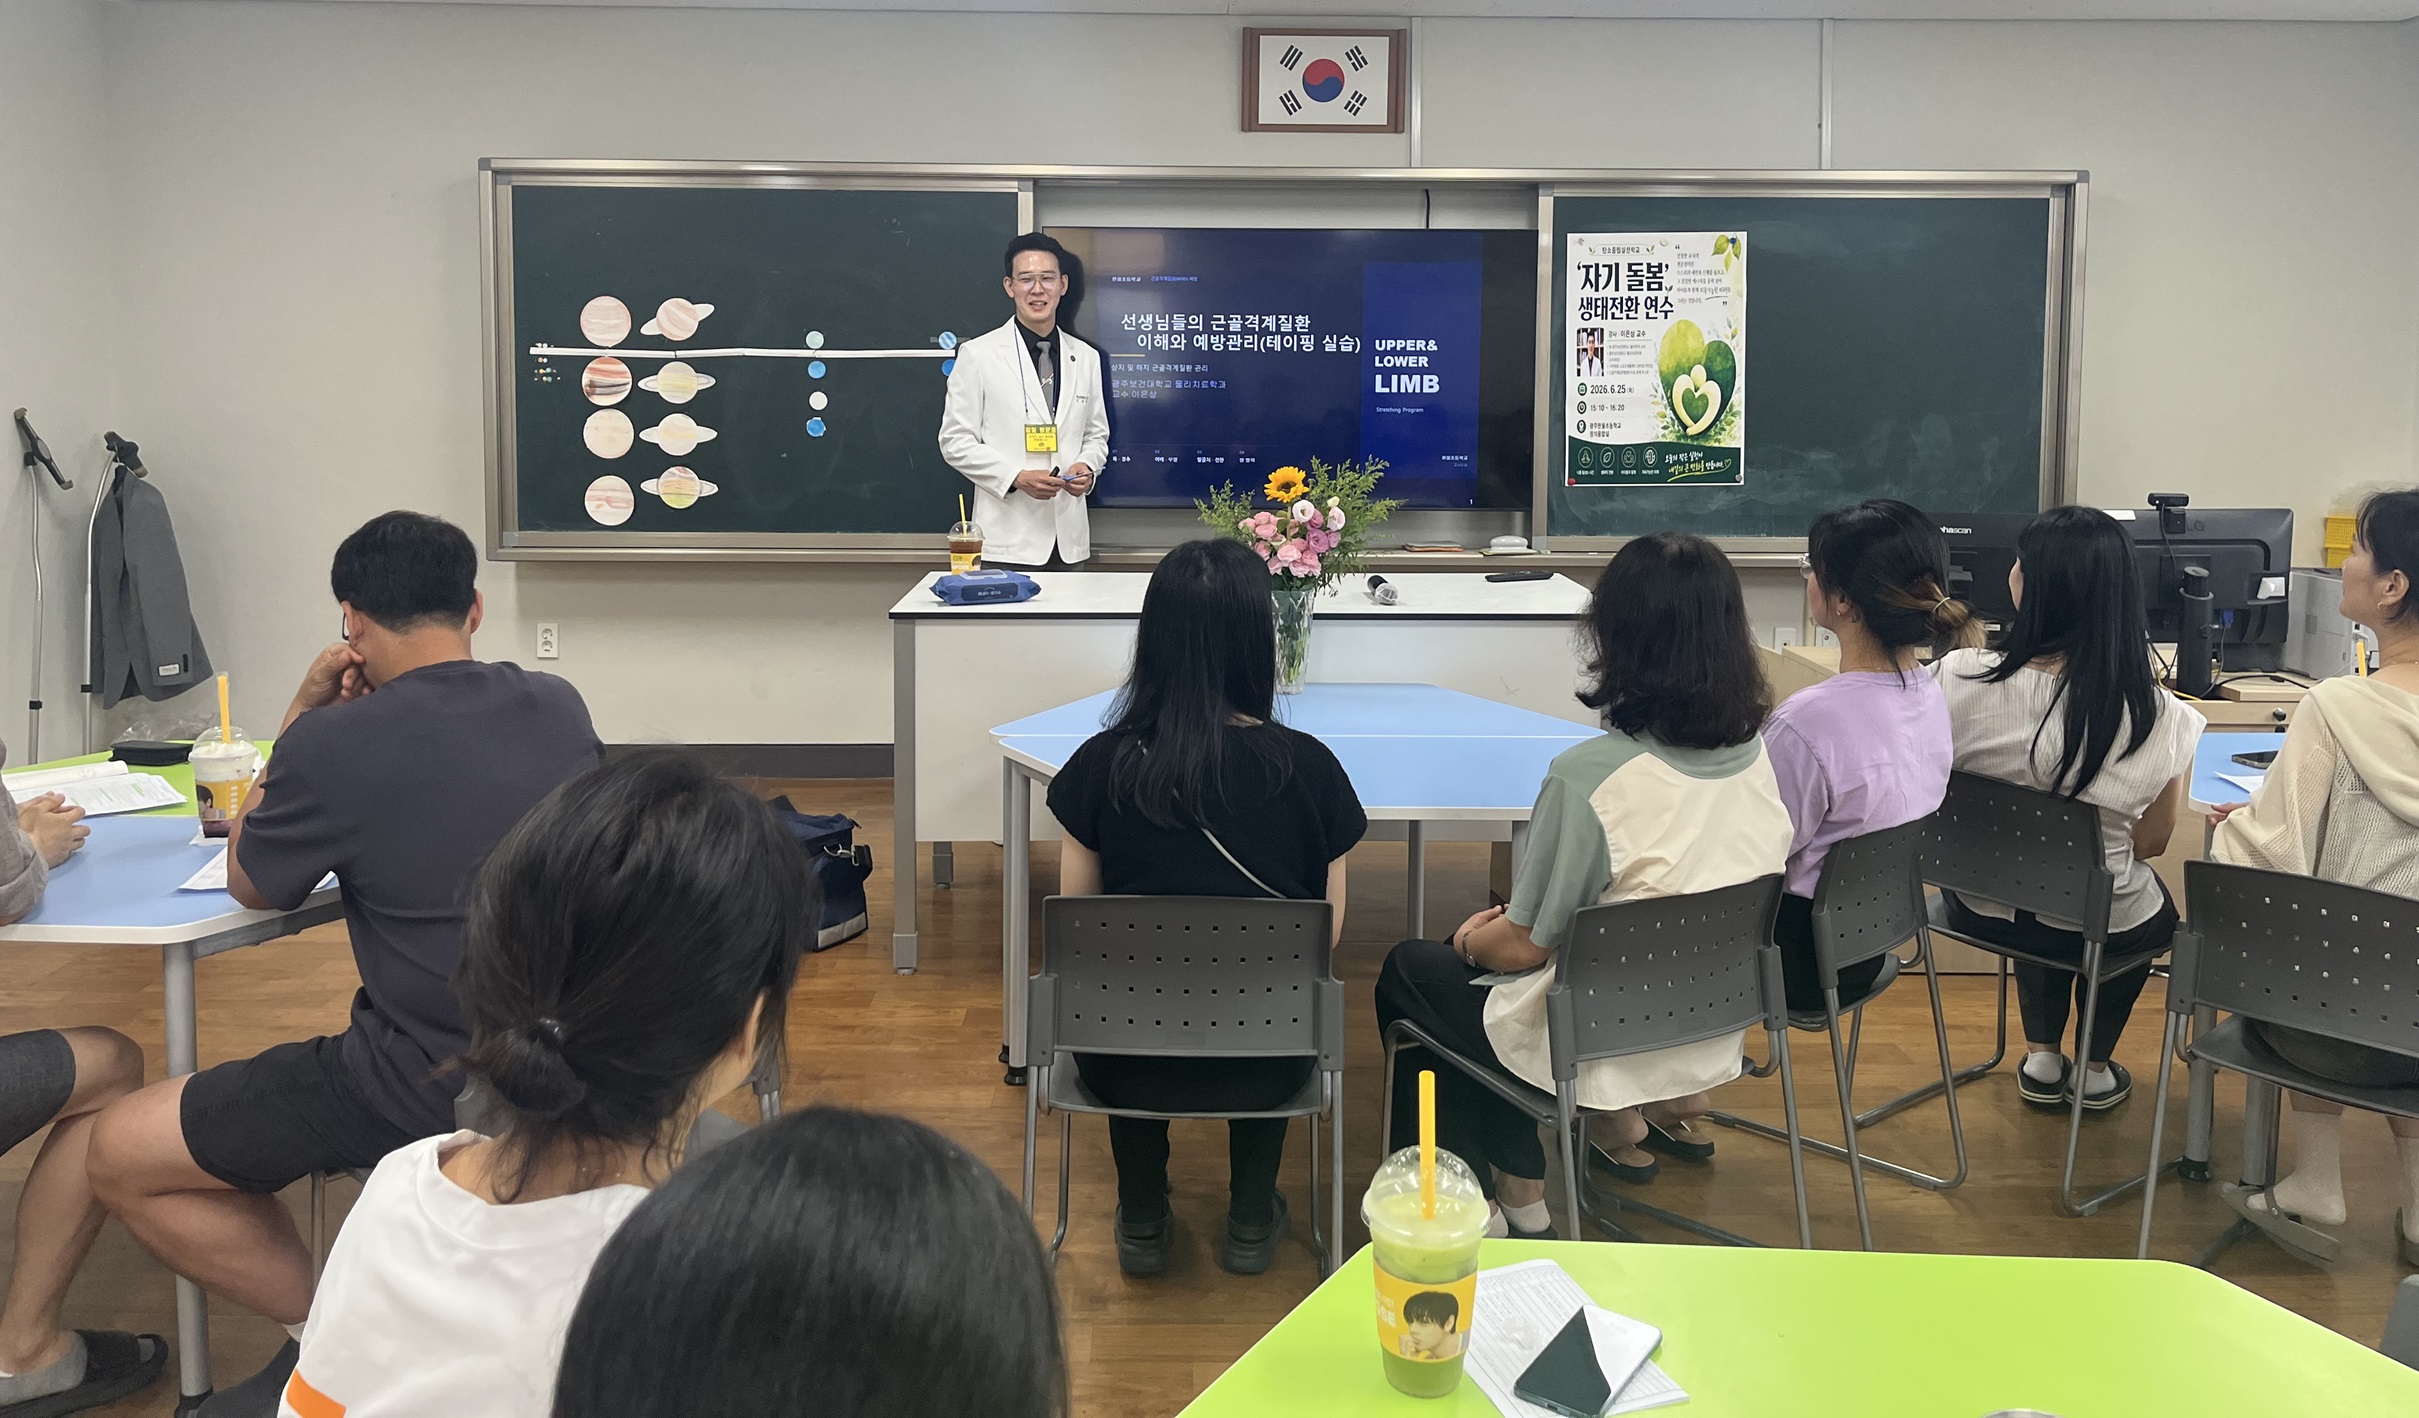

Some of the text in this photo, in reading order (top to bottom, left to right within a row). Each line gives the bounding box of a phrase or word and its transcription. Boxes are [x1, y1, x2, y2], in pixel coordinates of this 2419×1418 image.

[1578, 296, 1674, 321] 생태전환 연수
[1121, 313, 1311, 332] 선생님들의 근골격계질환
[1620, 330, 1635, 338] 이은상
[1137, 334, 1361, 353] 이해와 예방관리(테이핑 실습)
[1375, 340, 1438, 351] UPPER&
[1375, 356, 1429, 367] LOWER
[1112, 380, 1226, 389] 광주보건대학교 물리치료학과
[1375, 374, 1440, 393] LIMB
[1112, 390, 1157, 399] 교수 이은상
